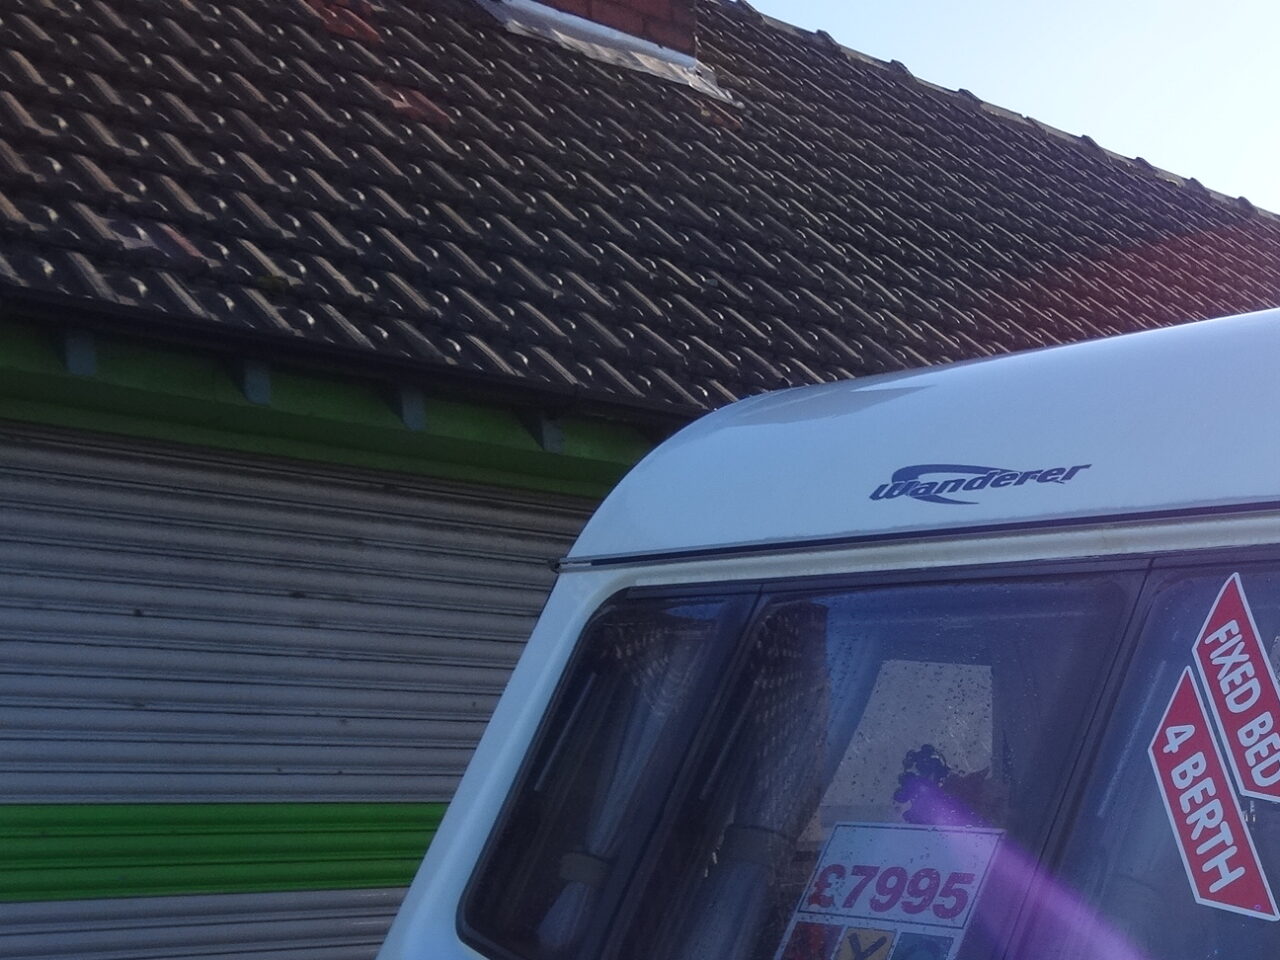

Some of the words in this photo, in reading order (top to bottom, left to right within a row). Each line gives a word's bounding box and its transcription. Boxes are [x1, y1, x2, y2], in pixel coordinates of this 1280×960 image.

[1204, 619, 1262, 714] FIXED
[1163, 724, 1196, 754] 4
[1170, 751, 1246, 894] BERTH
[807, 863, 976, 920] £7995
